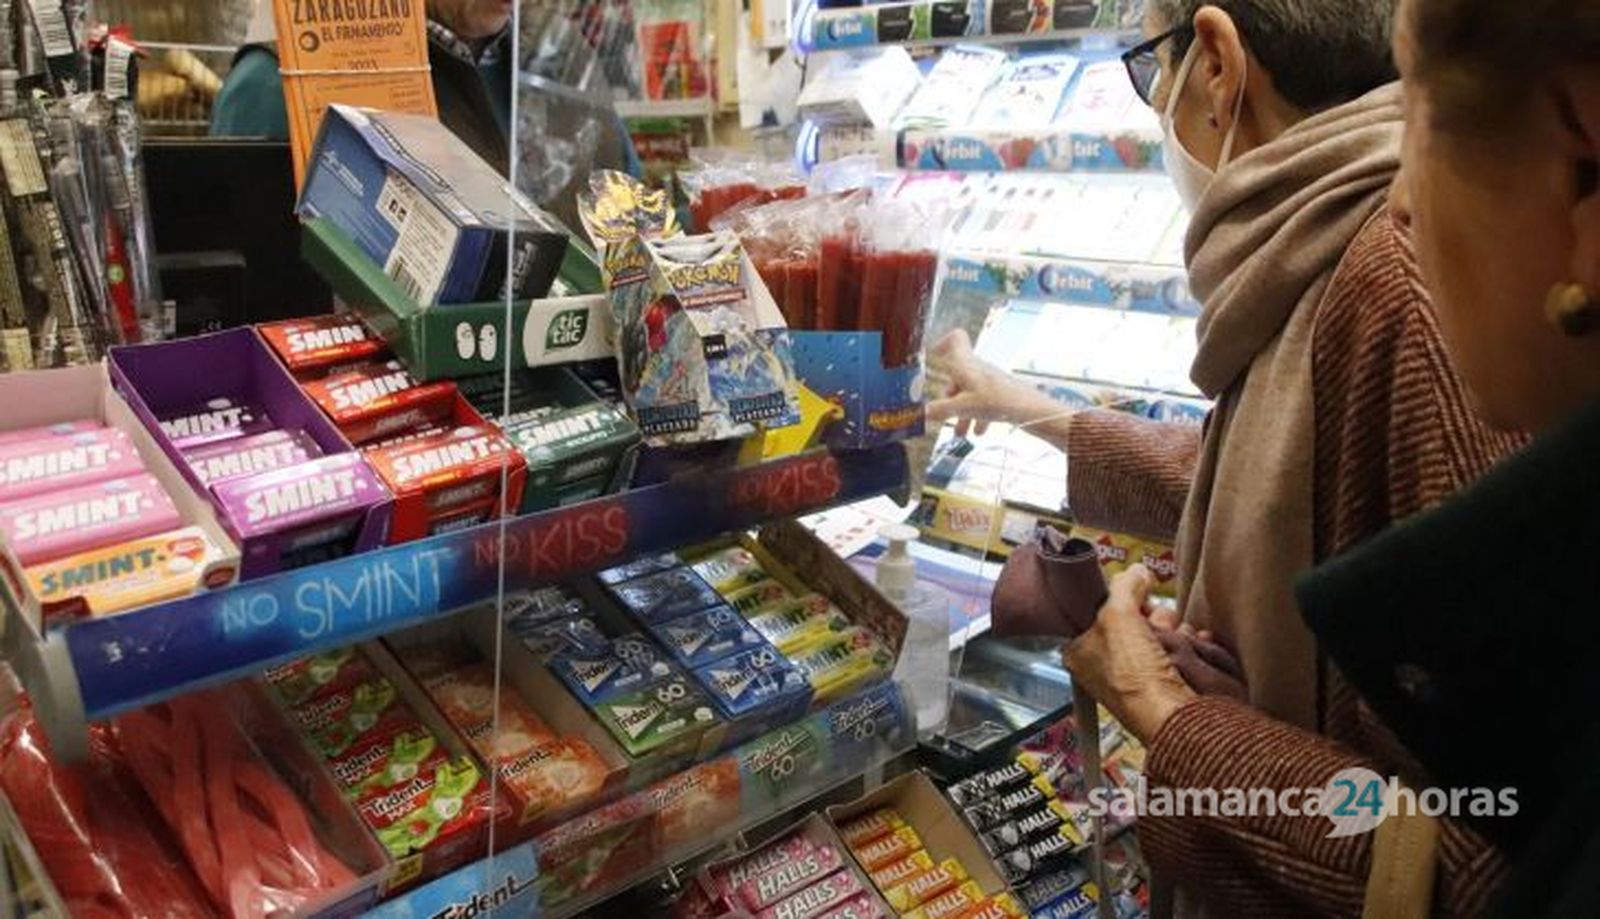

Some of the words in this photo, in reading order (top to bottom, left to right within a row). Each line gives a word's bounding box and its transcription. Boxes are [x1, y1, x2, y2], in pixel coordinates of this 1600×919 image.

[946, 264, 979, 283] rbit
[1037, 263, 1094, 295] Orbit
[560, 313, 583, 329] tic
[286, 324, 367, 352] SMIN
[552, 328, 581, 346] tac
[161, 407, 243, 439] MINT
[519, 411, 601, 448] SMINT
[392, 436, 489, 483] SMINT
[246, 473, 353, 523] SMINT
[767, 455, 842, 512] KISS
[14, 491, 142, 540] SMINT
[529, 506, 629, 576] KISS
[40, 547, 155, 593] SMINT
[221, 594, 279, 633] NO
[297, 547, 452, 640] SMINT
[658, 684, 685, 702] 60
[614, 700, 659, 730] Trident
[500, 747, 553, 778] Trident
[746, 729, 809, 771] Trident
[771, 754, 795, 779] 60
[986, 762, 1025, 788] HALLS
[370, 777, 436, 814] Trident
[1002, 784, 1040, 810] HALLS
[1019, 808, 1058, 834] HALLS
[859, 834, 902, 861] HALLS
[1030, 832, 1069, 859] HALLS
[729, 845, 790, 888] HALLS
[758, 854, 819, 901] HALLS
[875, 856, 916, 885] HALLS
[907, 867, 950, 896] HALLS
[776, 880, 837, 919] HALLS
[925, 890, 969, 919] HALLS
[1053, 892, 1090, 919] HALLS
